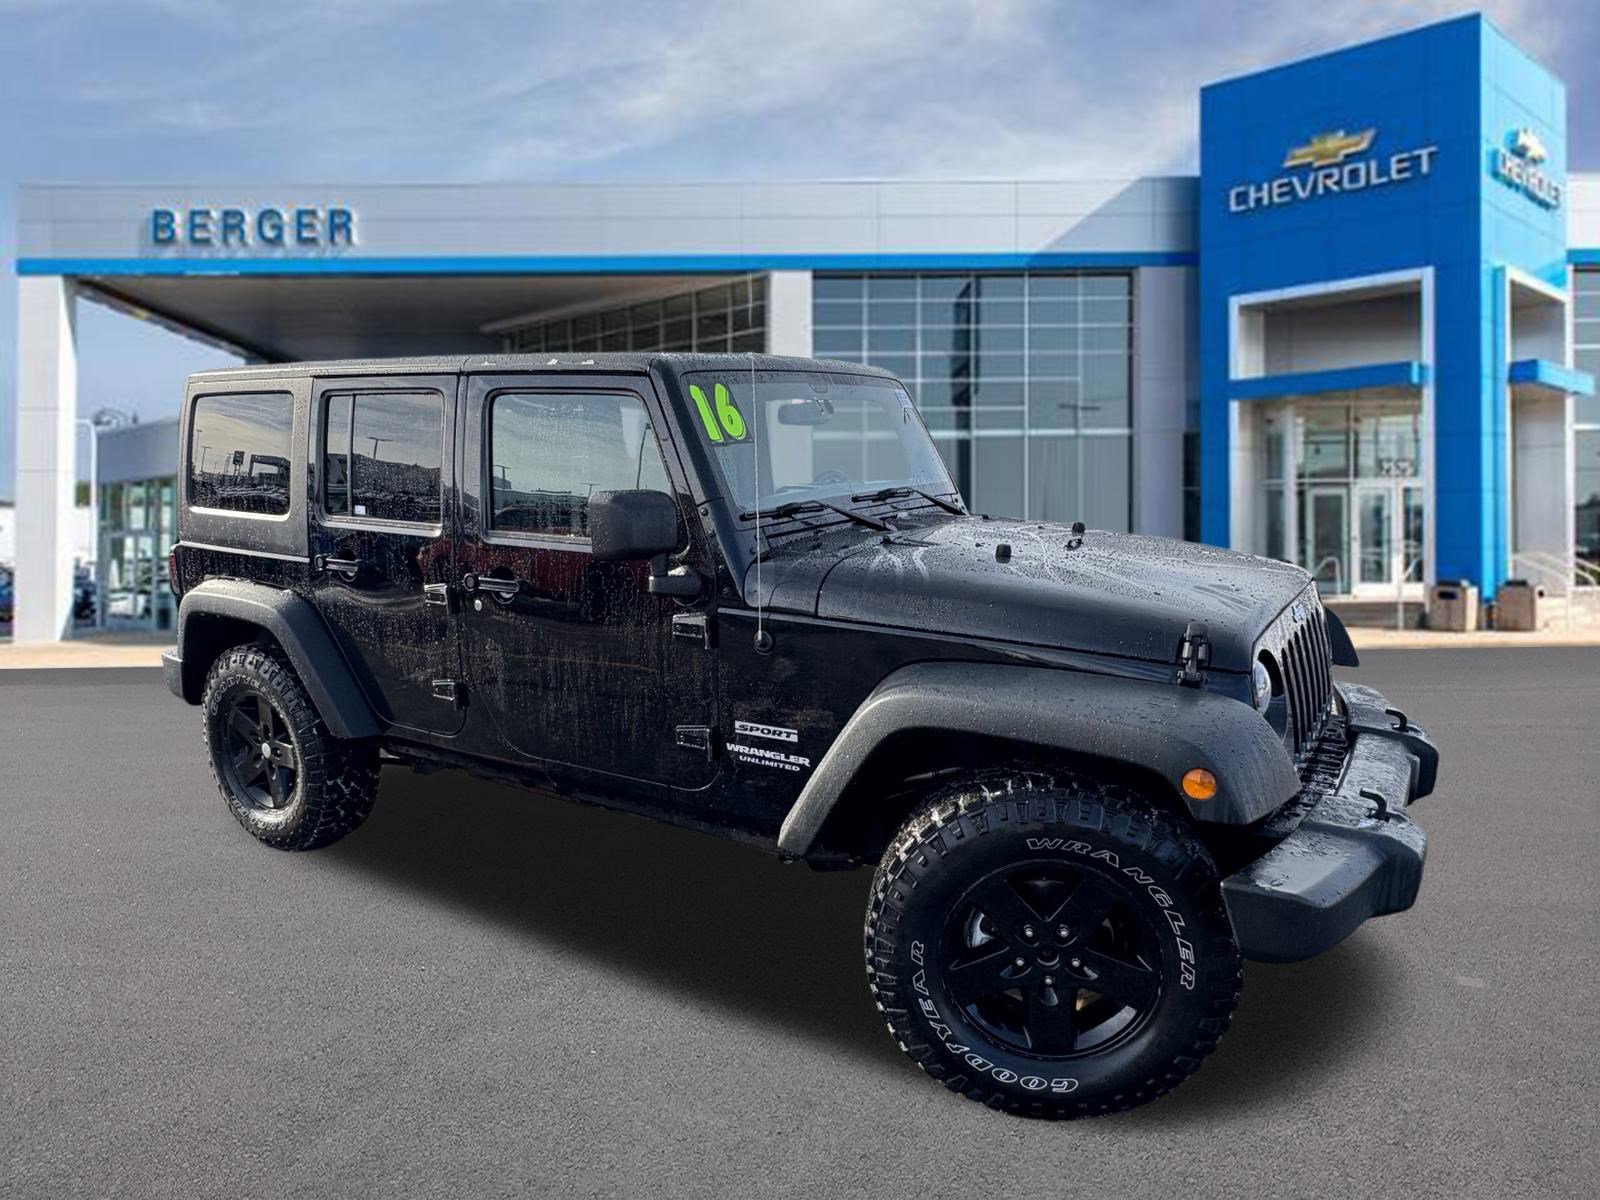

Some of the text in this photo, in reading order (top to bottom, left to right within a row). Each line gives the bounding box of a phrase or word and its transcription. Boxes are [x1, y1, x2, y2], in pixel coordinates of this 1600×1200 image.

[1229, 146, 1438, 212] CHEVROLET
[151, 207, 355, 246] BERGER
[689, 383, 747, 442] 16
[726, 742, 811, 767] WRANGLER
[737, 722, 796, 740] SPORT
[739, 755, 800, 772] UNLIMITED
[1026, 838, 1195, 990] WRANGLER
[911, 940, 1079, 1092] GOODYEAR
